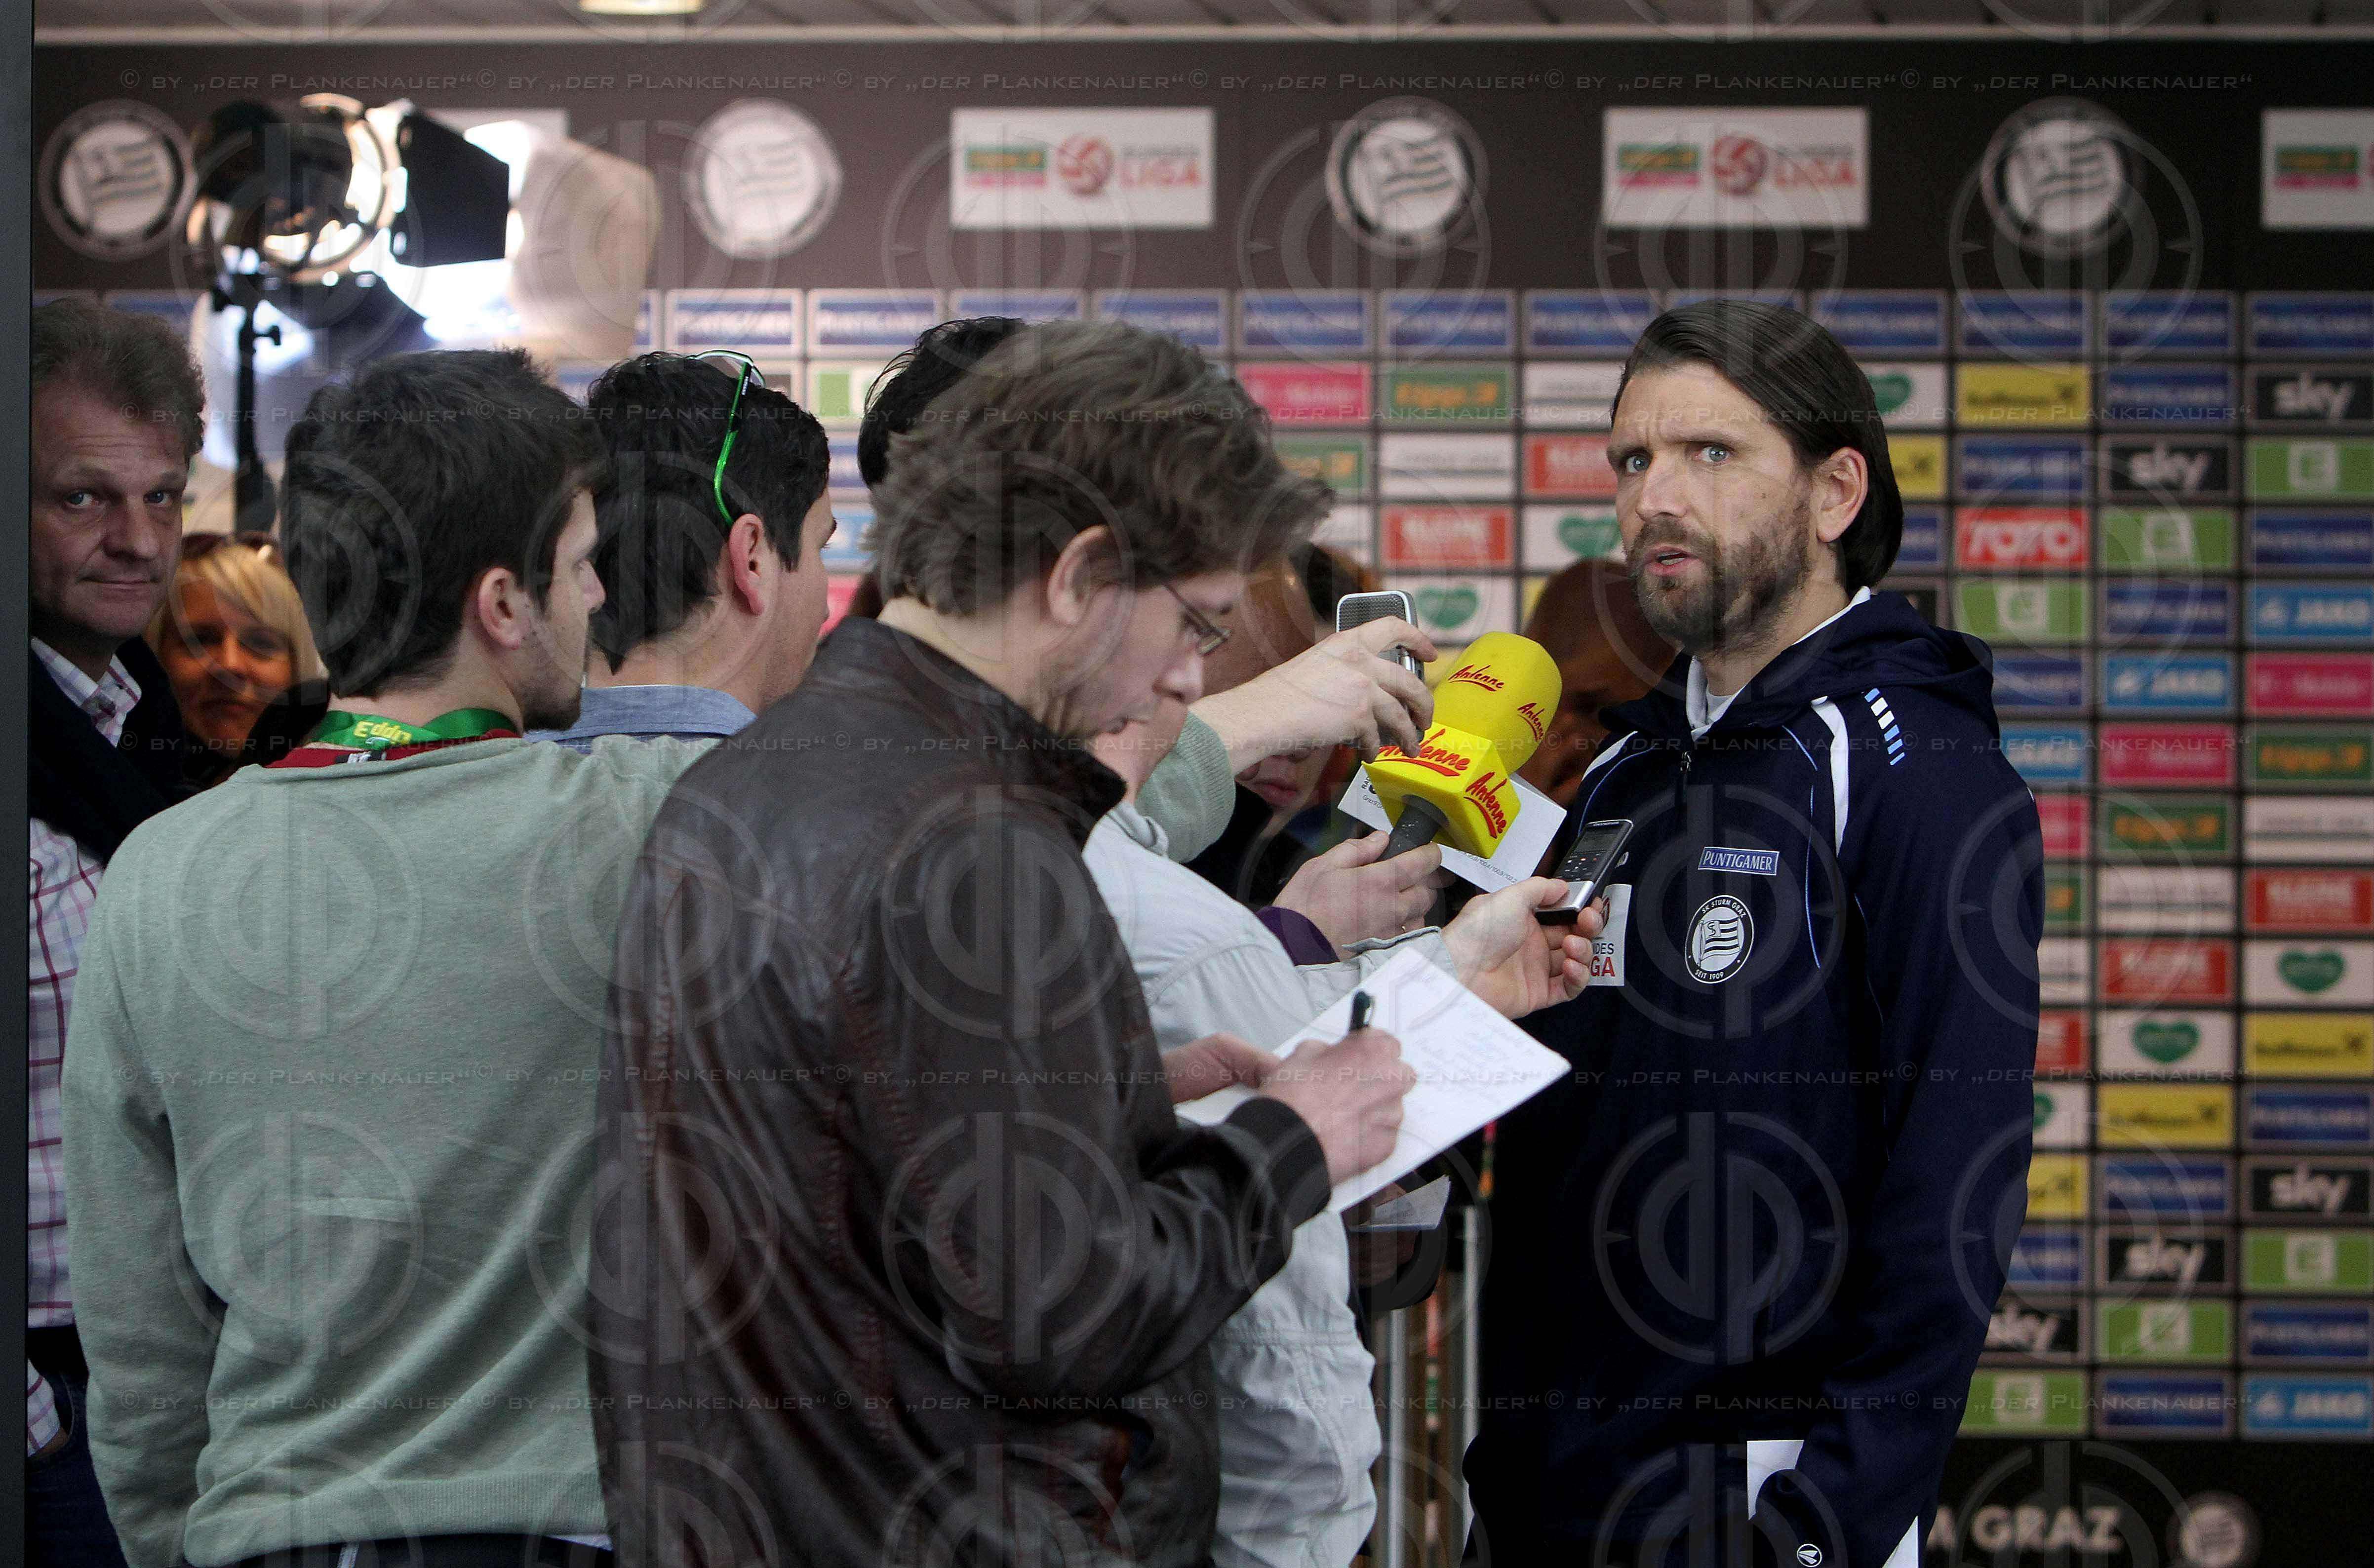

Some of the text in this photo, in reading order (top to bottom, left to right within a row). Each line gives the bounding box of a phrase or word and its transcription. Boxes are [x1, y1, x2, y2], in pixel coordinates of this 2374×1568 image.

[2274, 372, 2355, 425] sky
[2128, 440, 2209, 491] sky
[1448, 665, 1504, 690] Antenne
[1465, 772, 1507, 834] Antenne
[1703, 851, 1772, 871] PUNTIGAMER
[1702, 899, 1746, 918] SK STURM GRAZ
[1590, 956, 1616, 978] GA
[1592, 942, 1615, 955] DES
[1695, 969, 1724, 980] SEIT 1909
[2270, 1163, 2351, 1217] sky
[2125, 1234, 2205, 1287] sky
[1972, 1504, 2123, 1553] GRAZ
